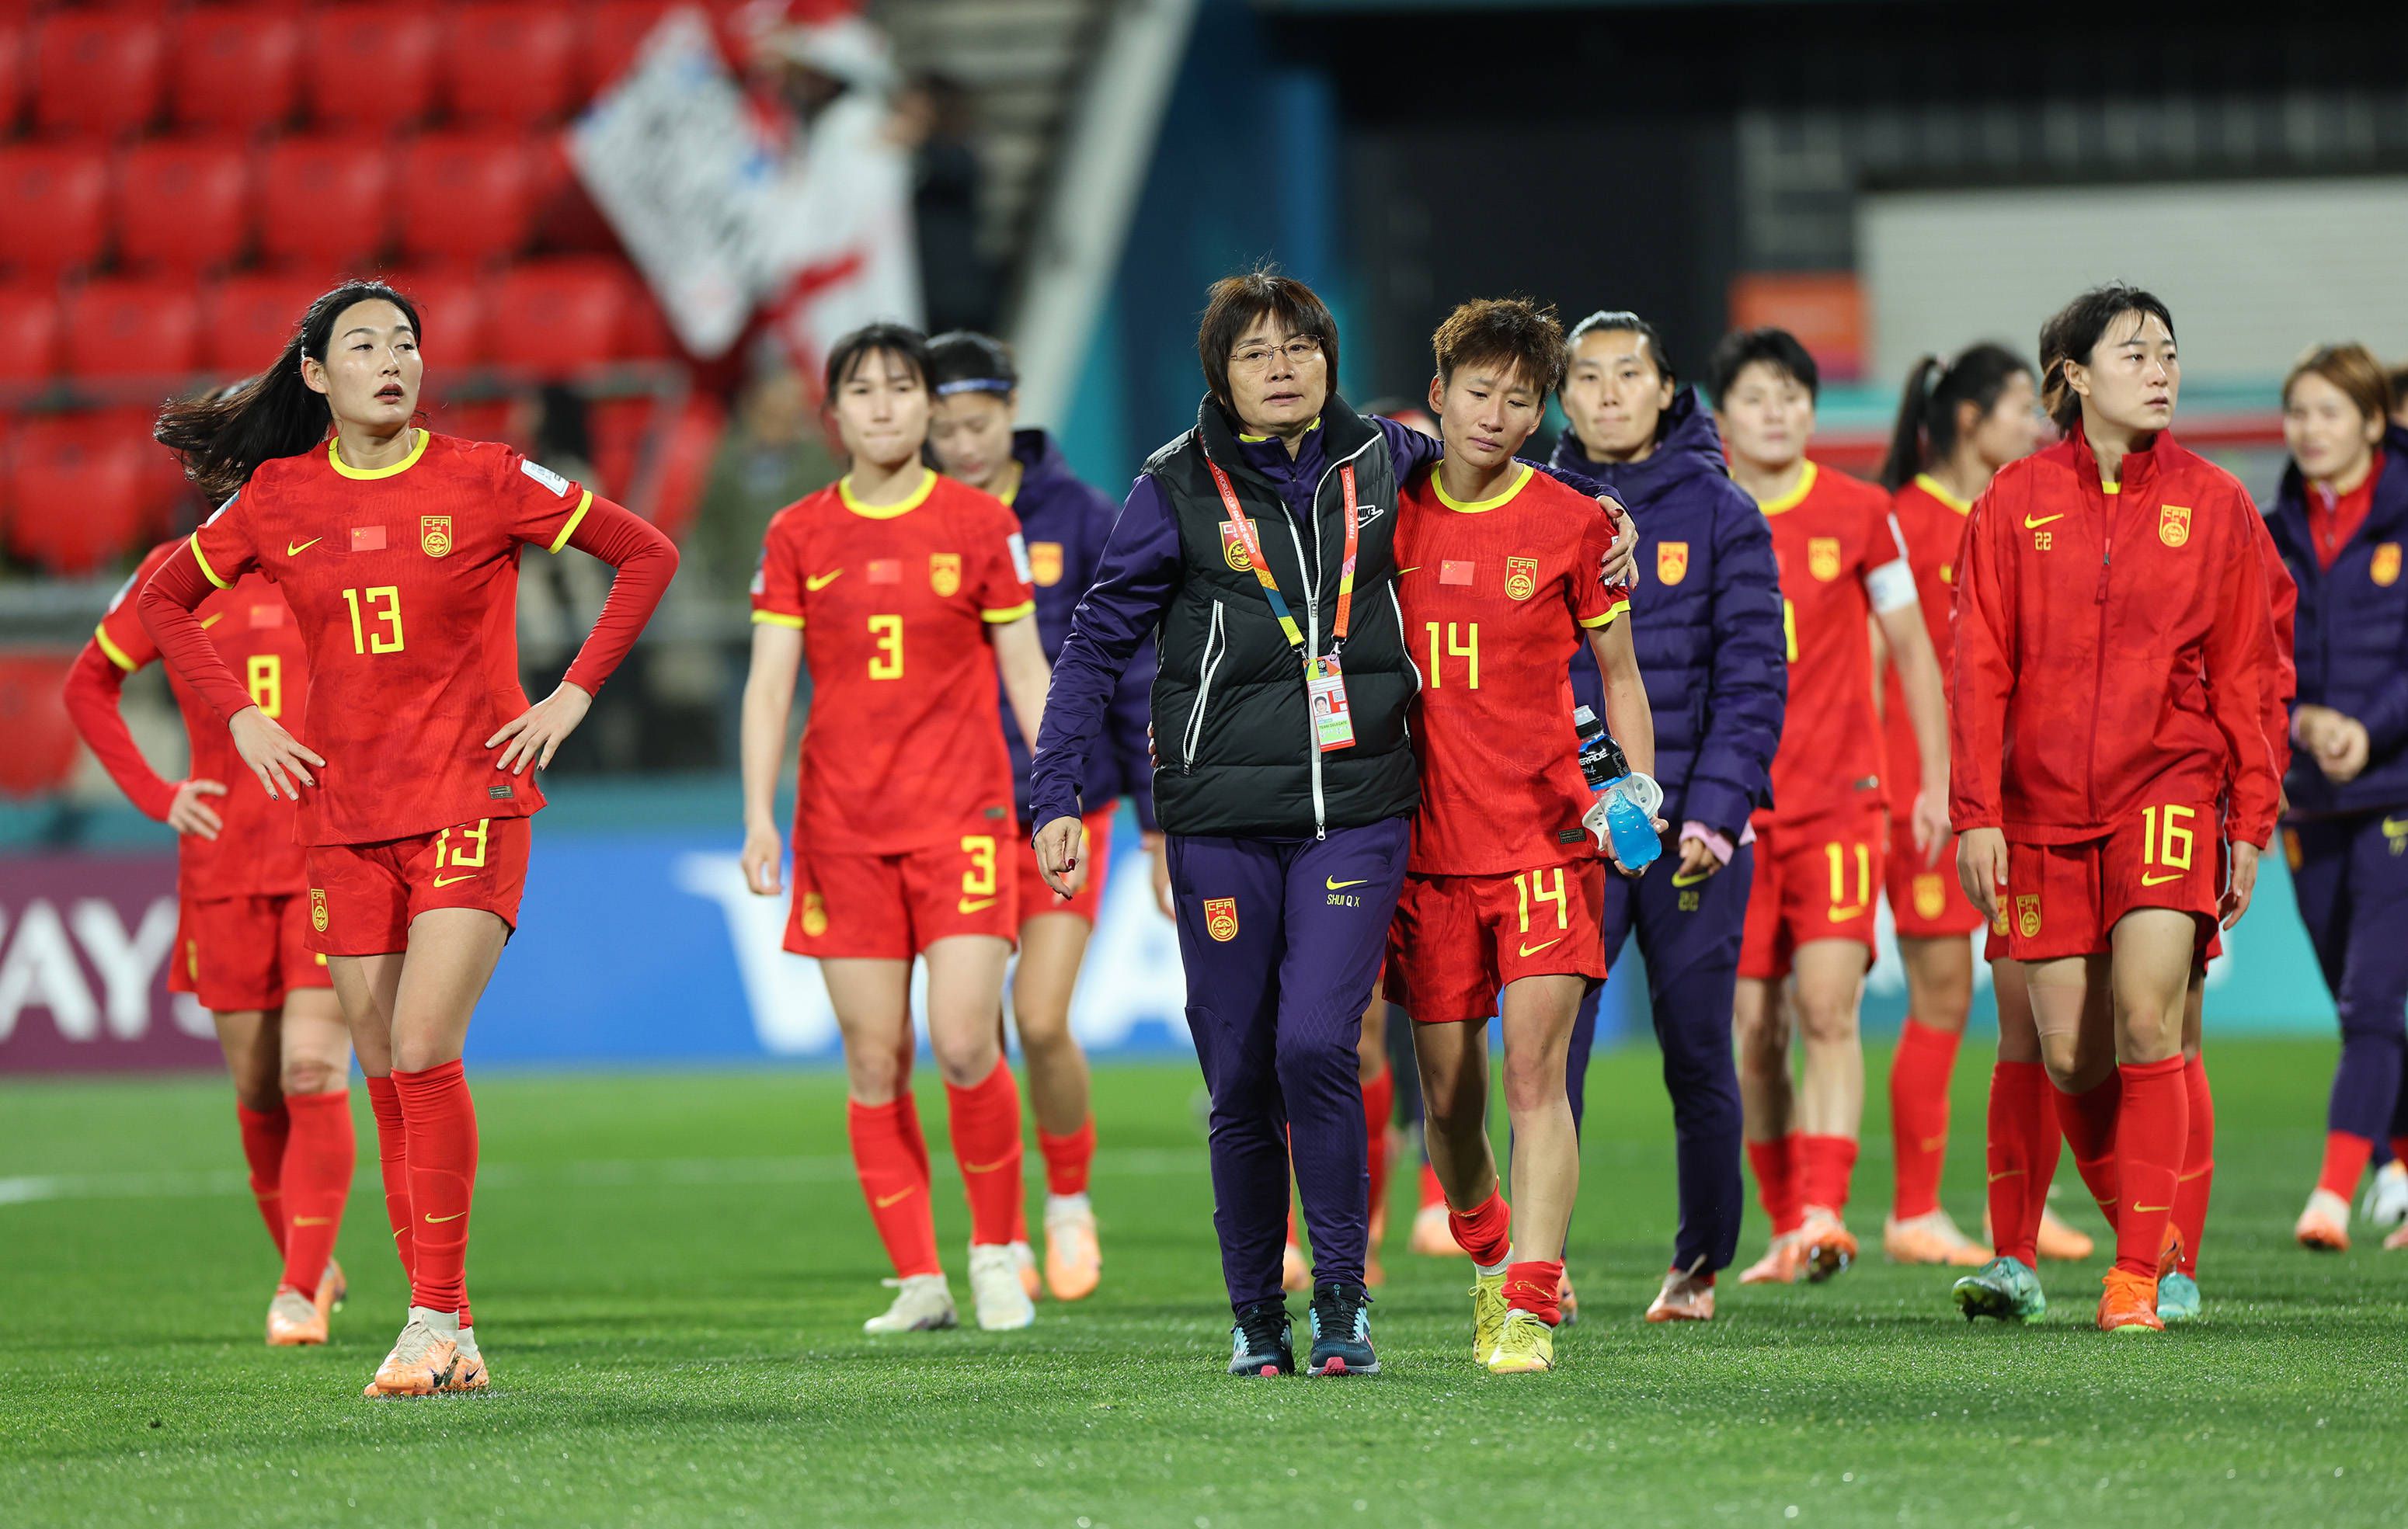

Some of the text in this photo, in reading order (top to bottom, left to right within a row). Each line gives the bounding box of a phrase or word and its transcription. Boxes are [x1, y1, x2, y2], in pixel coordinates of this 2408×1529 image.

[1218, 475, 1231, 497] WORLD
[1227, 498, 1238, 509] CUP
[1358, 507, 1374, 518] NIKE
[1510, 560, 1535, 570] CFA
[2035, 532, 2051, 550] 22
[343, 586, 404, 654] 13
[868, 614, 903, 680] 3
[1426, 622, 1479, 689] 14
[248, 655, 281, 718] 8
[436, 818, 489, 868] 13
[961, 836, 997, 895] 3
[2142, 804, 2194, 870] 16
[1327, 894, 1360, 907] SHUI Q X
[1514, 868, 1567, 933] 14
[1825, 843, 1869, 907] 11
[1208, 901, 1232, 911] CFA
